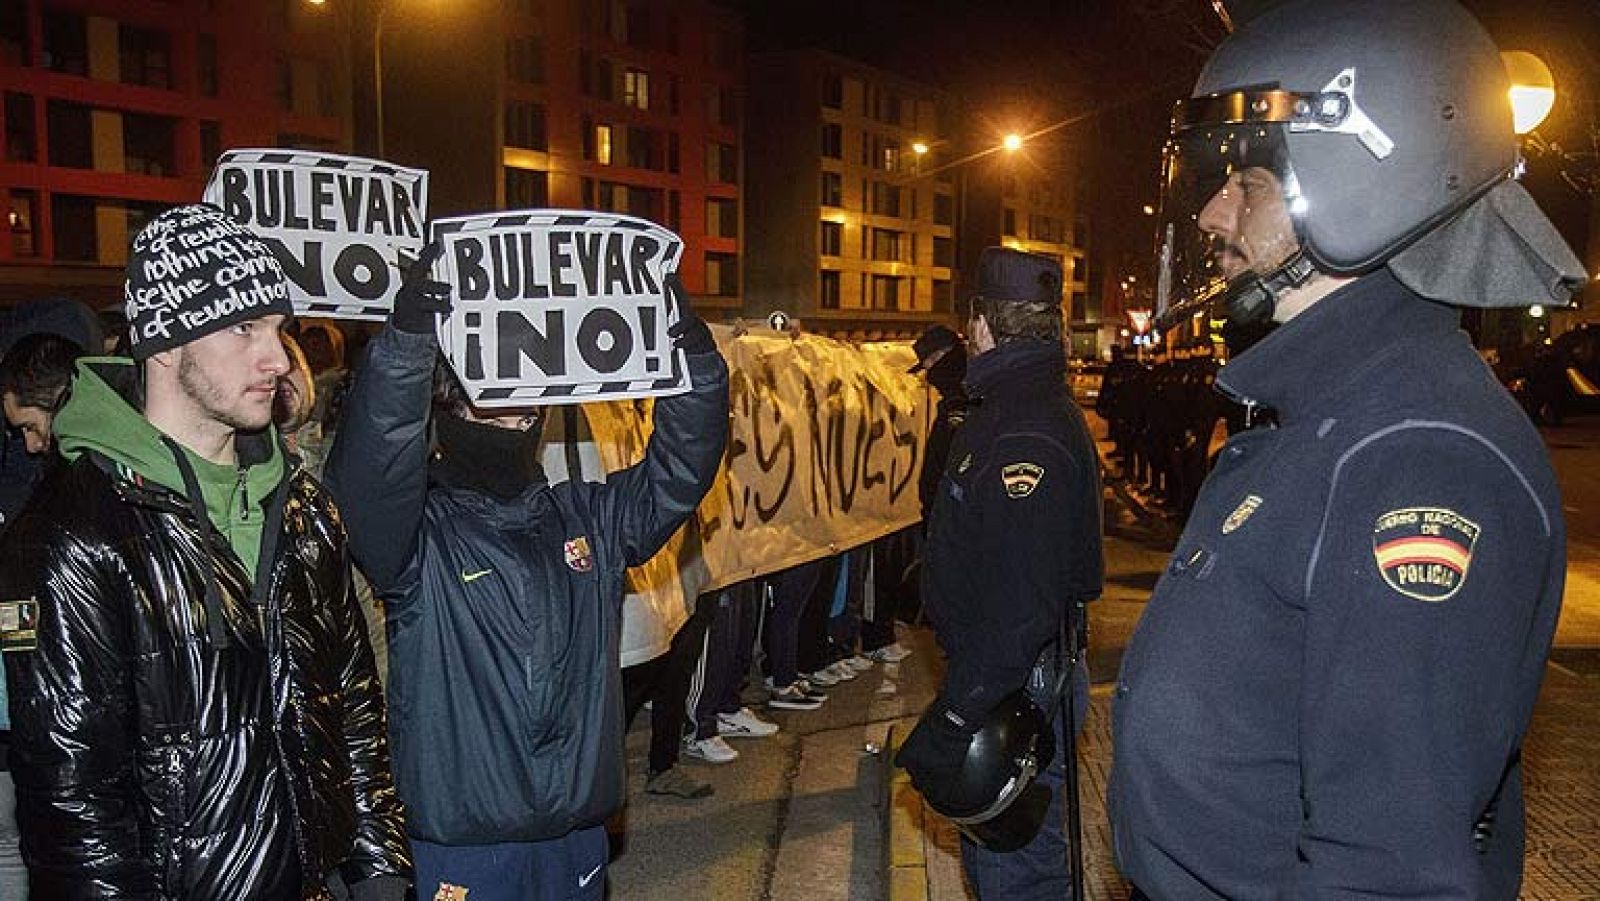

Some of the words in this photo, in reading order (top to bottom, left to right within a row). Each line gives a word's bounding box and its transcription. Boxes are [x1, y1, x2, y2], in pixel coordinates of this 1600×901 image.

[223, 168, 420, 238] BULEVAR
[453, 231, 661, 300] BULEVAR
[143, 306, 175, 338] of
[466, 305, 662, 380] ¡NO!
